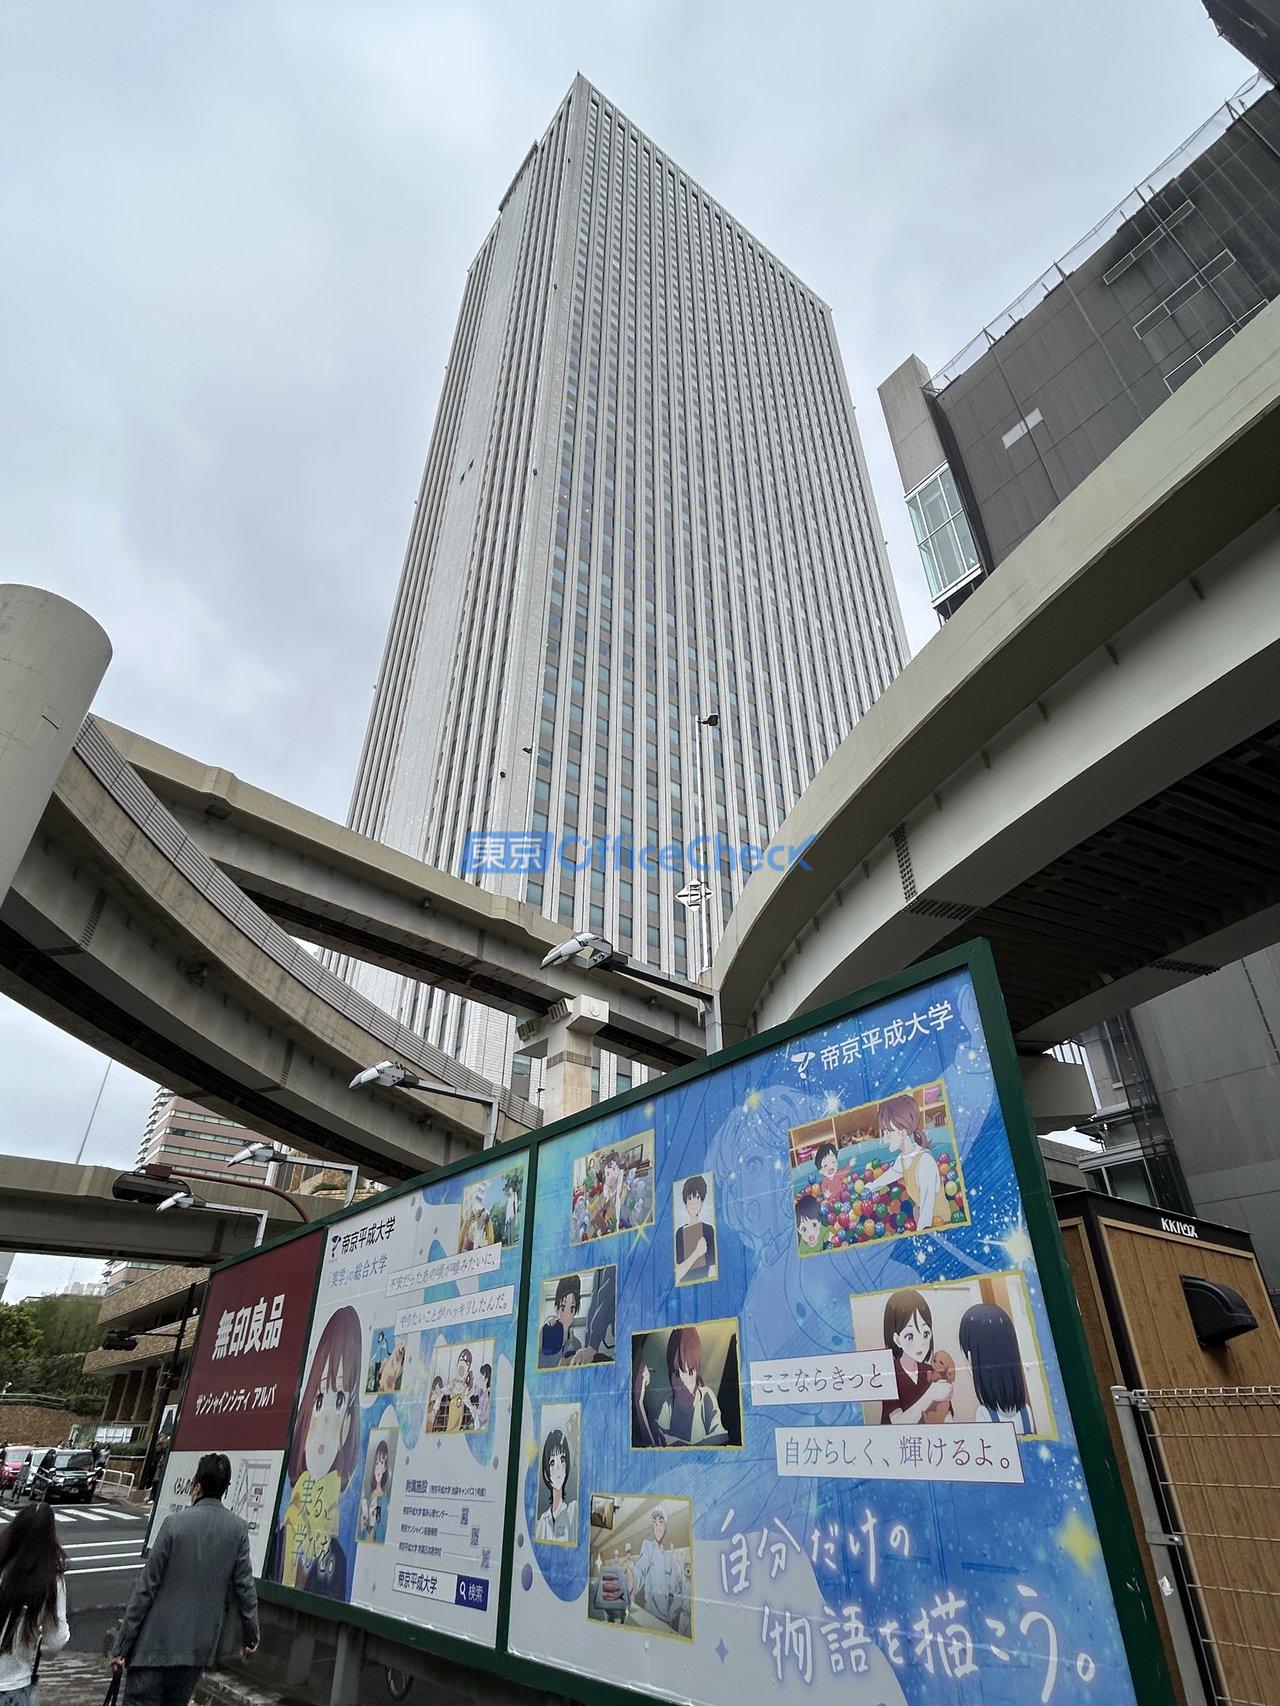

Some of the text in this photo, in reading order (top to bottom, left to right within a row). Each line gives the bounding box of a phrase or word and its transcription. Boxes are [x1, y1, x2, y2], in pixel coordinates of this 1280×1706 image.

[820, 1000, 954, 1071] 帝京平成大学
[341, 1216, 397, 1255] 帝京平成大学
[1161, 1217, 1199, 1239] KKハウス
[327, 1254, 388, 1288] 「実学」の総合大学
[211, 1294, 285, 1361] 無印良品
[399, 1293, 508, 1328] やりたいことがハッキリしたんだ。
[761, 1363, 884, 1394] ここならきっと
[195, 1384, 278, 1416] サンシャインシティ アルパ
[785, 1436, 1010, 1470] 自分らしく、輝けるよ。
[297, 1475, 328, 1518] 実る、
[291, 1524, 335, 1574] 学びを。
[719, 1508, 910, 1594] 自分だけの
[397, 1569, 484, 1603] 帝京平成大学 検索
[760, 1584, 1096, 1703] 物語を描こう。
